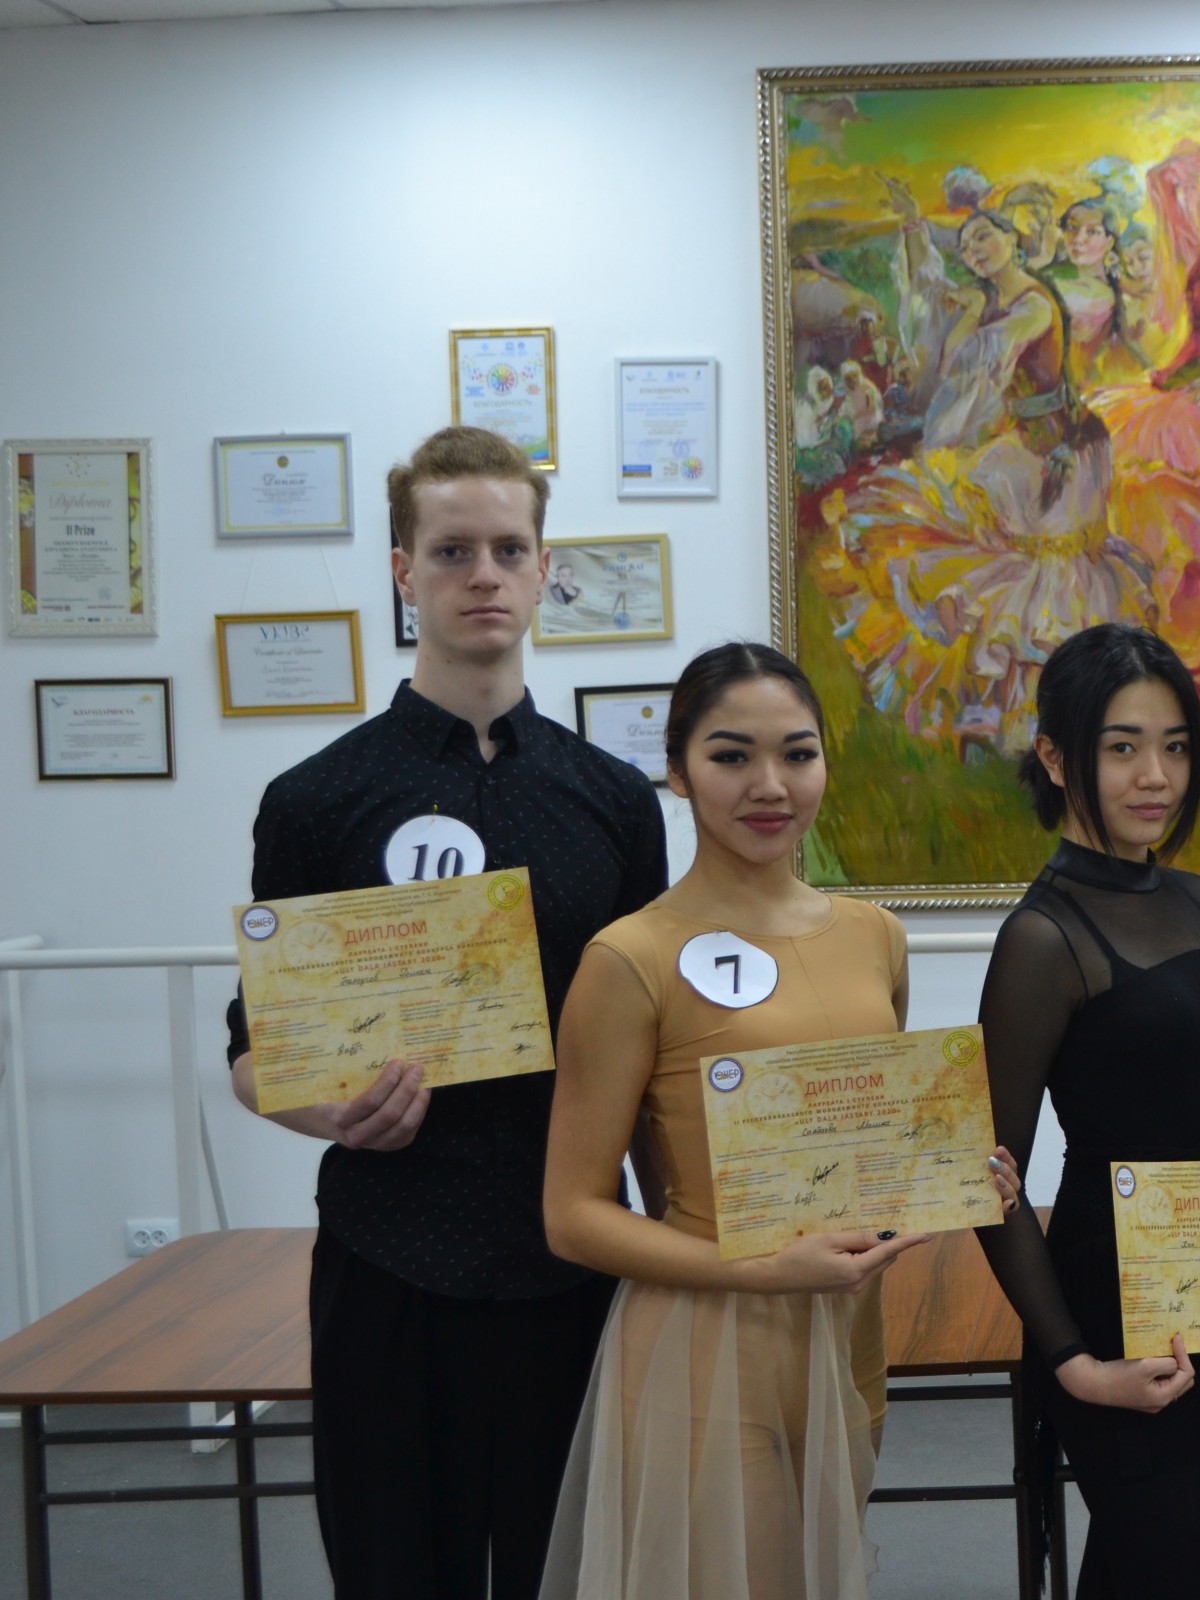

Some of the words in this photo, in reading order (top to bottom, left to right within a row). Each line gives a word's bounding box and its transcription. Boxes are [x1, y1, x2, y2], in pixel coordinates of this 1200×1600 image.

[66, 525, 73, 536] II
[74, 525, 96, 537] Prize
[408, 842, 466, 880] 10
[344, 920, 427, 947] ДИПЛОМ
[714, 954, 741, 994] 7
[804, 1073, 885, 1098] ДИПЛОМ
